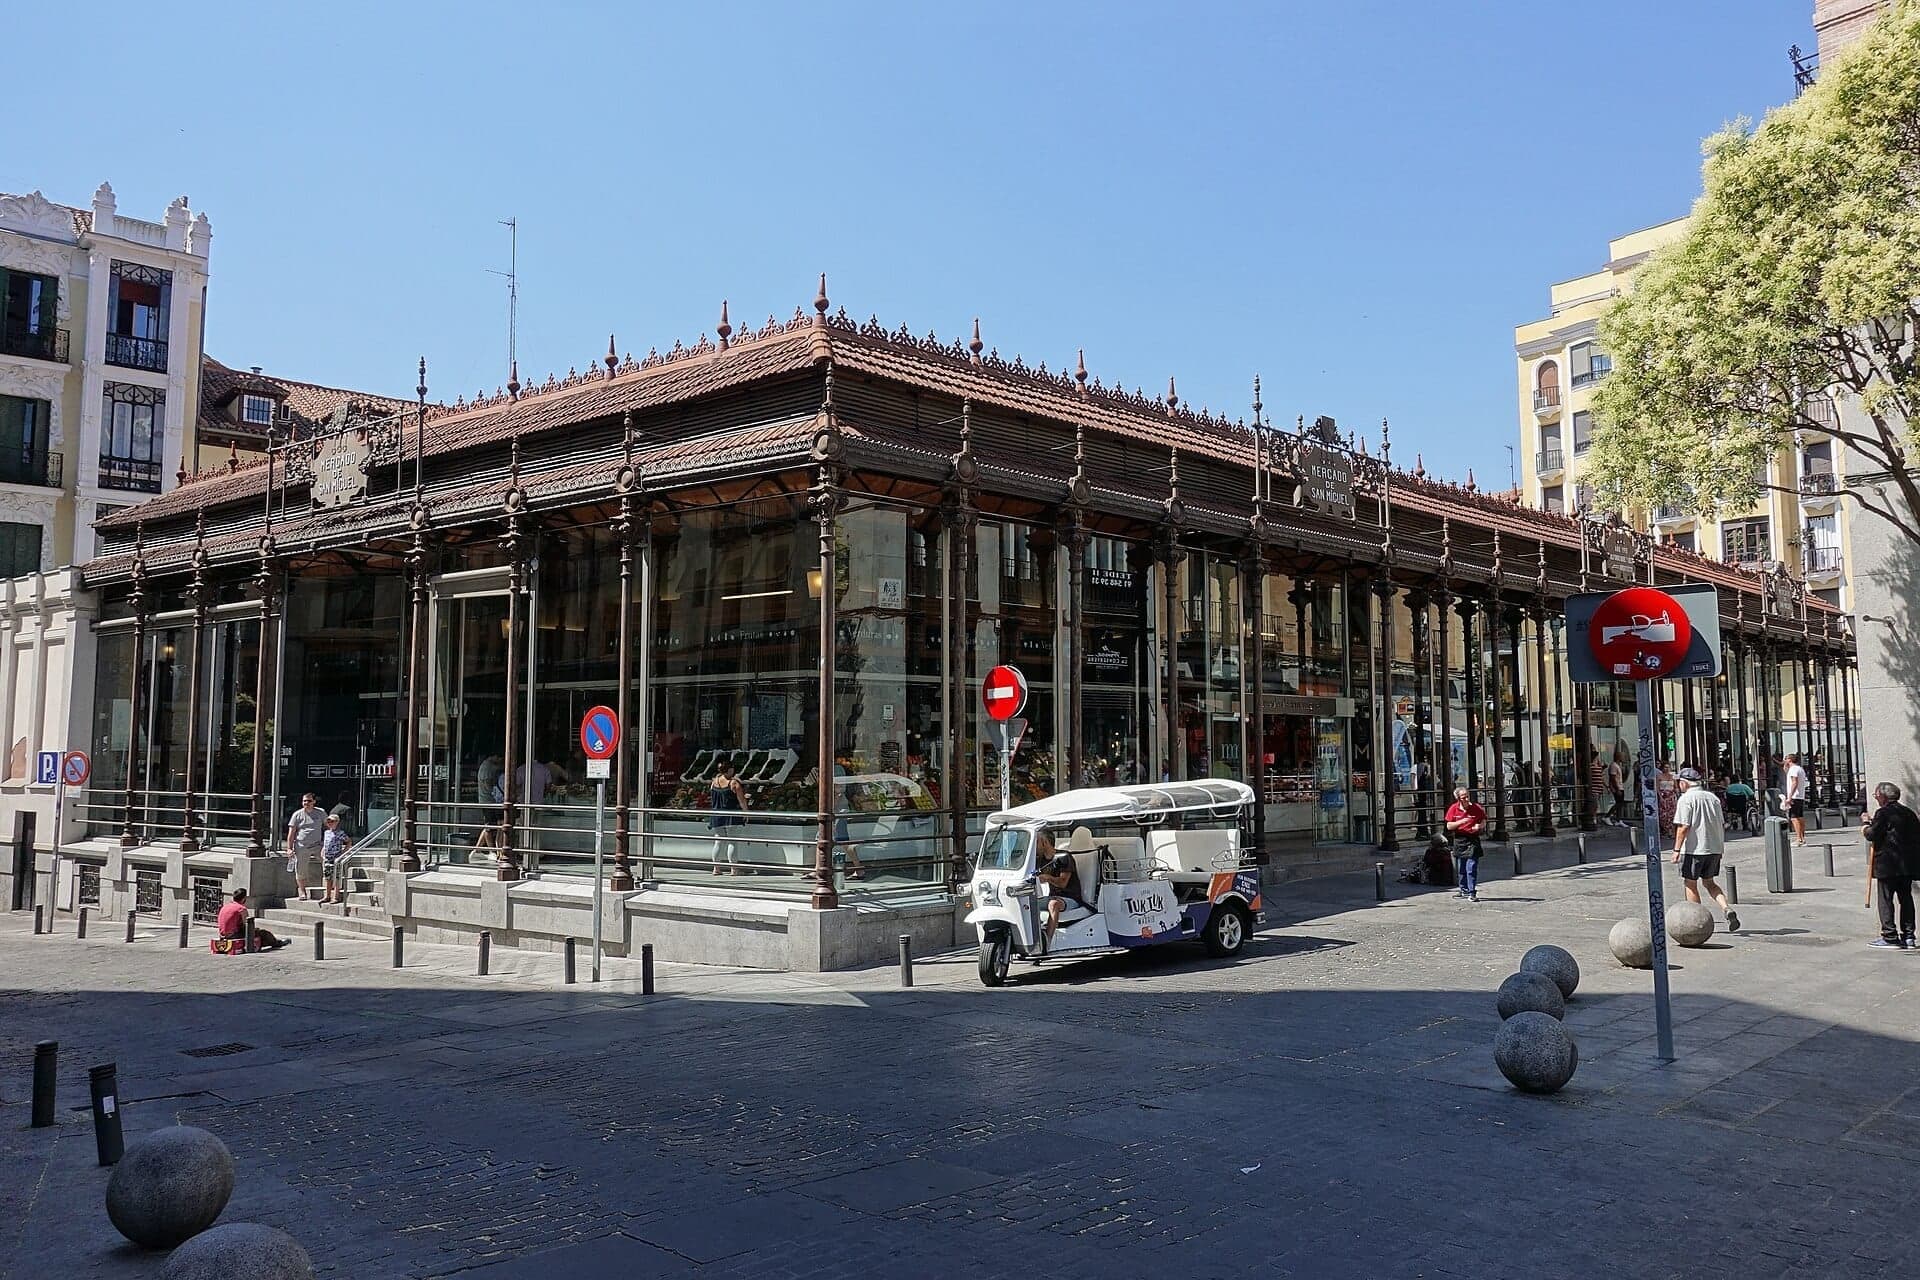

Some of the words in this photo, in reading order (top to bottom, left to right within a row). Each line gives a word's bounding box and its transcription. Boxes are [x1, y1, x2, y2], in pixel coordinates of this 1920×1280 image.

[320, 452, 356, 472] MERCADO
[333, 470, 343, 479] DE
[1311, 465, 1347, 483] MERCADO
[319, 482, 332, 496] SAN
[332, 476, 358, 493] MIGUEL
[1325, 481, 1335, 490] DE
[1311, 487, 1325, 500] SAN
[1326, 490, 1350, 506] MIGUEL
[42, 754, 53, 781] P
[1124, 897, 1146, 913] TUK
[1147, 893, 1164, 911] TUK
